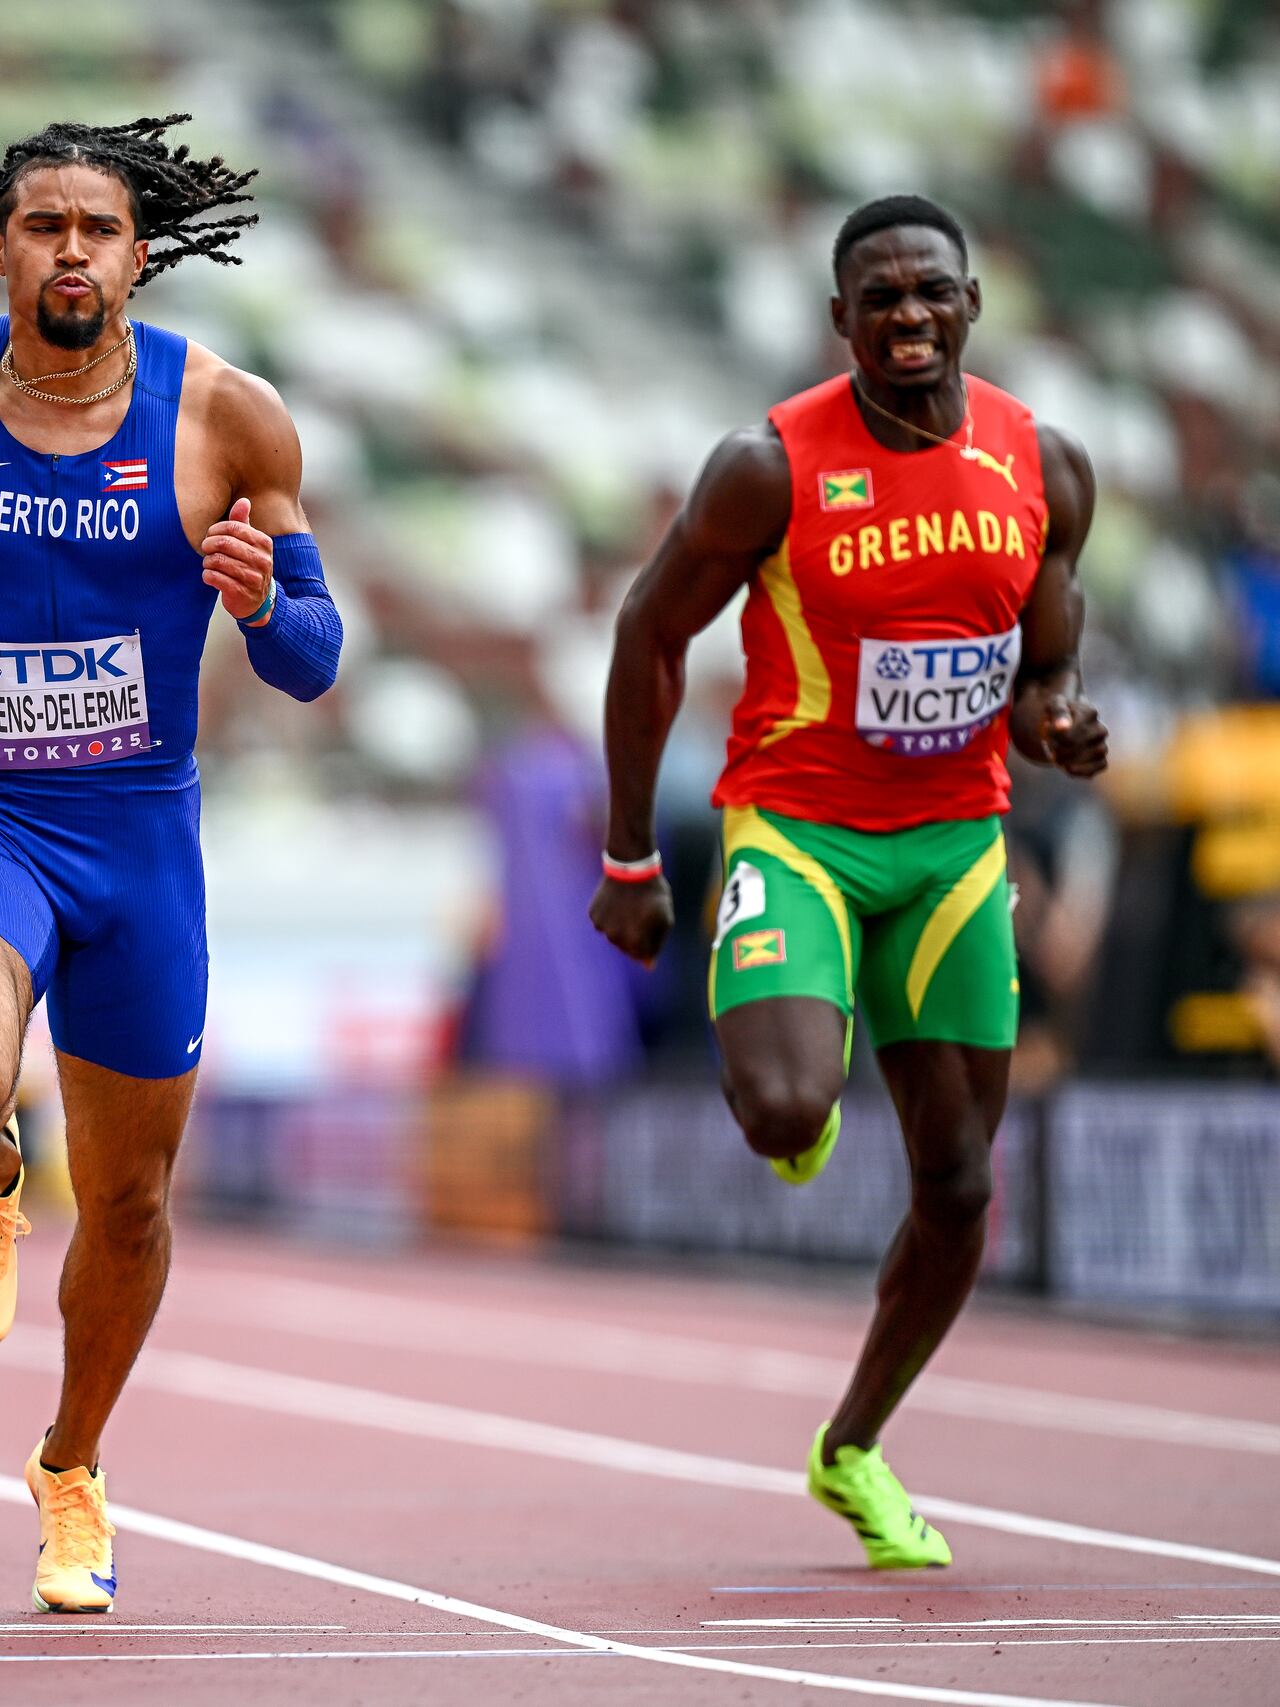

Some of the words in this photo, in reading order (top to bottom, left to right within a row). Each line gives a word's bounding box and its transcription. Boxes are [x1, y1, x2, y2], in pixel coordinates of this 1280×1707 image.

[75, 498, 140, 541] RICO
[829, 509, 1026, 577] GRENADA
[0, 642, 128, 684] TDK
[912, 637, 1012, 680] TDK
[871, 672, 1007, 724] VICTOR
